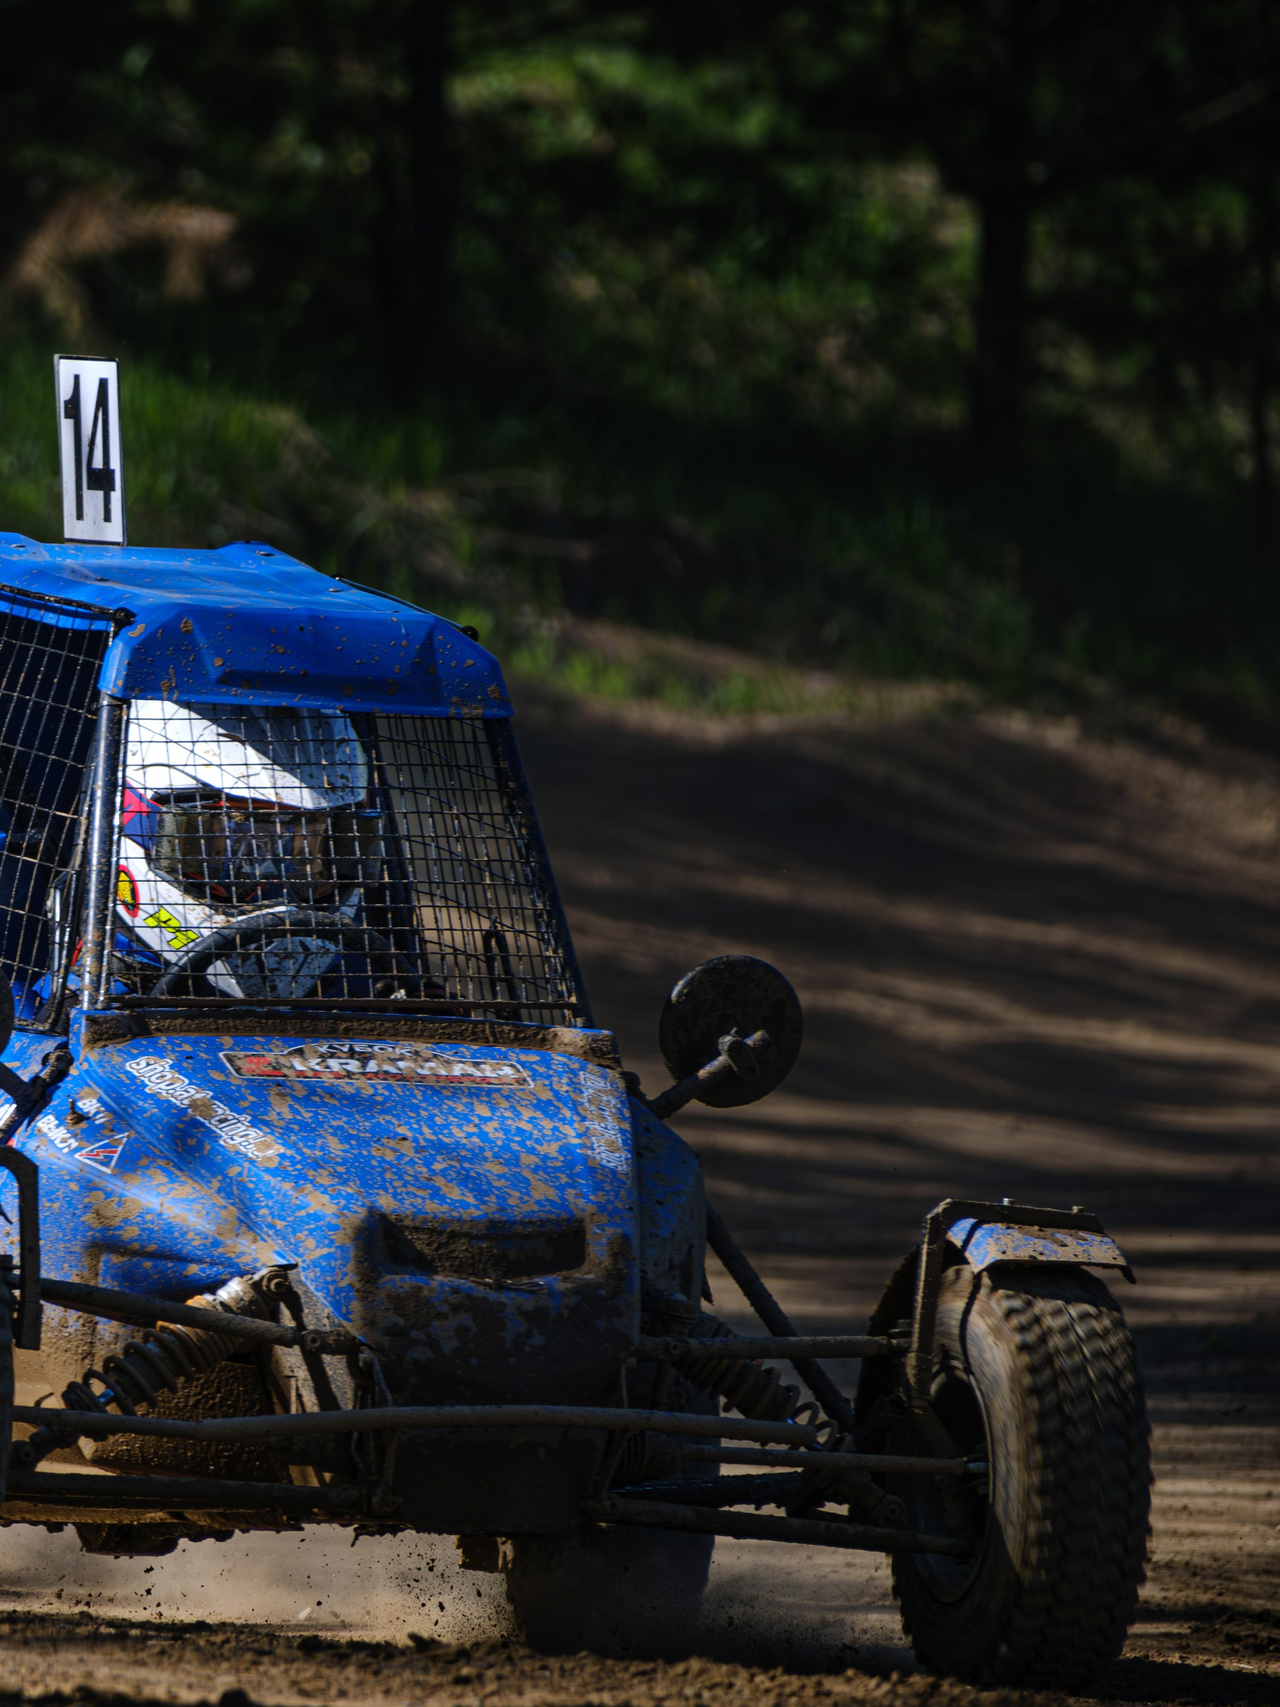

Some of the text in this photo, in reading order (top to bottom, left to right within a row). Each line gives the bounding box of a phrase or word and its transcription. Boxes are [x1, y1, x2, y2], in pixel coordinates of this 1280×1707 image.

[64, 373, 116, 523] 14
[316, 1044, 414, 1057] КУБОК
[36, 1114, 79, 1153] ВЫКЛ
